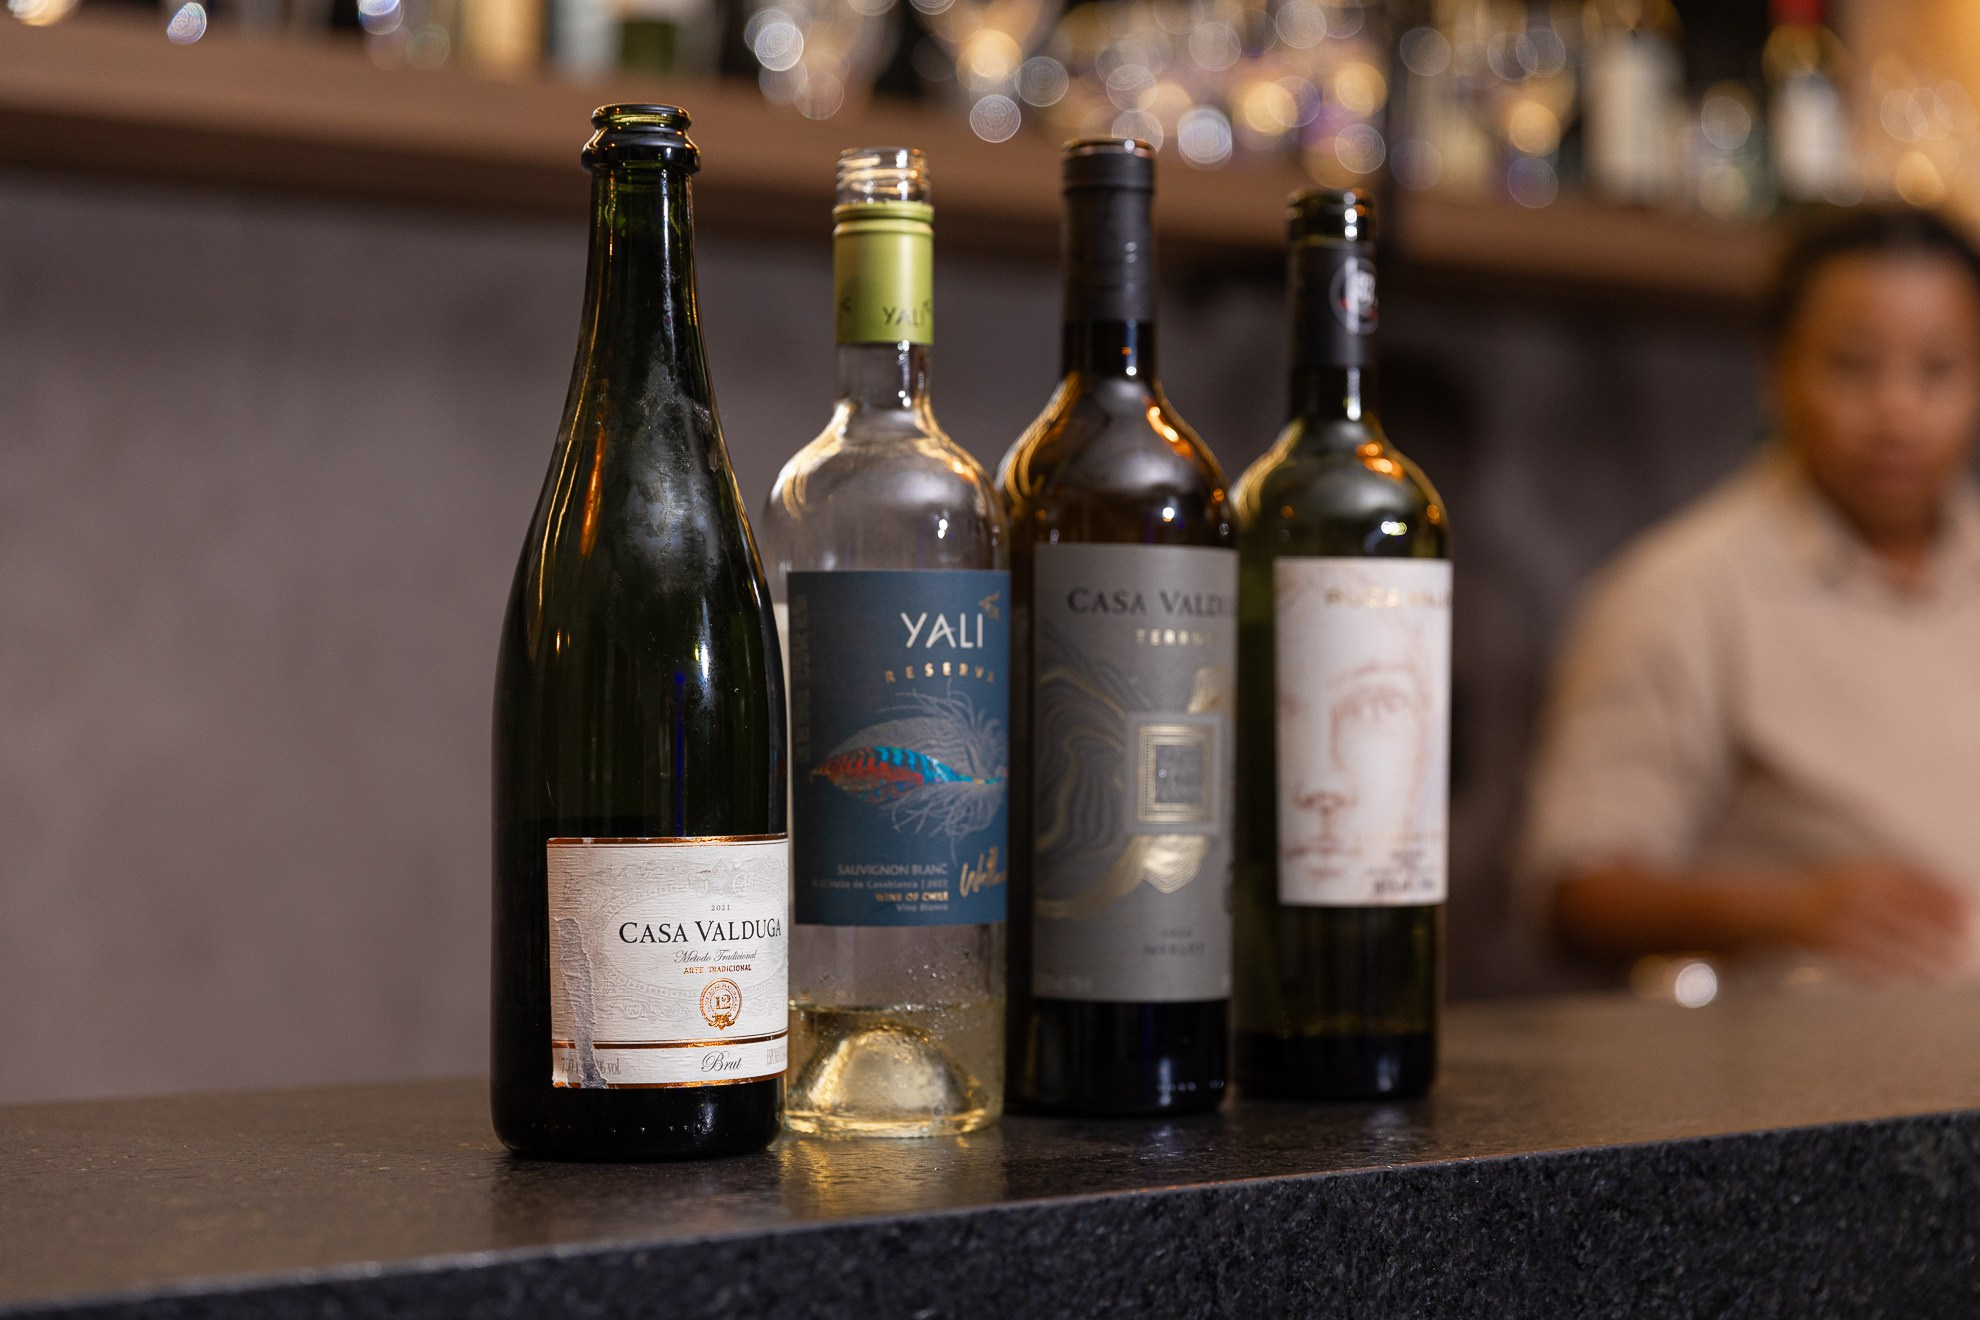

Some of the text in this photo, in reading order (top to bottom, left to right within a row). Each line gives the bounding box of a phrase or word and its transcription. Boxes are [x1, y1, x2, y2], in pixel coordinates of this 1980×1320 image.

[1067, 587, 1147, 615] CASA
[900, 612, 984, 649] YALI
[837, 863, 948, 876] SAUVIGNON BLANC
[905, 892, 919, 902] OF
[618, 917, 782, 945] CASA VALDUGA
[713, 949, 758, 962] Tradicional
[683, 963, 752, 975] ARTE TRADICIONAL
[714, 994, 731, 1010] 12
[701, 1050, 742, 1073] Brut
